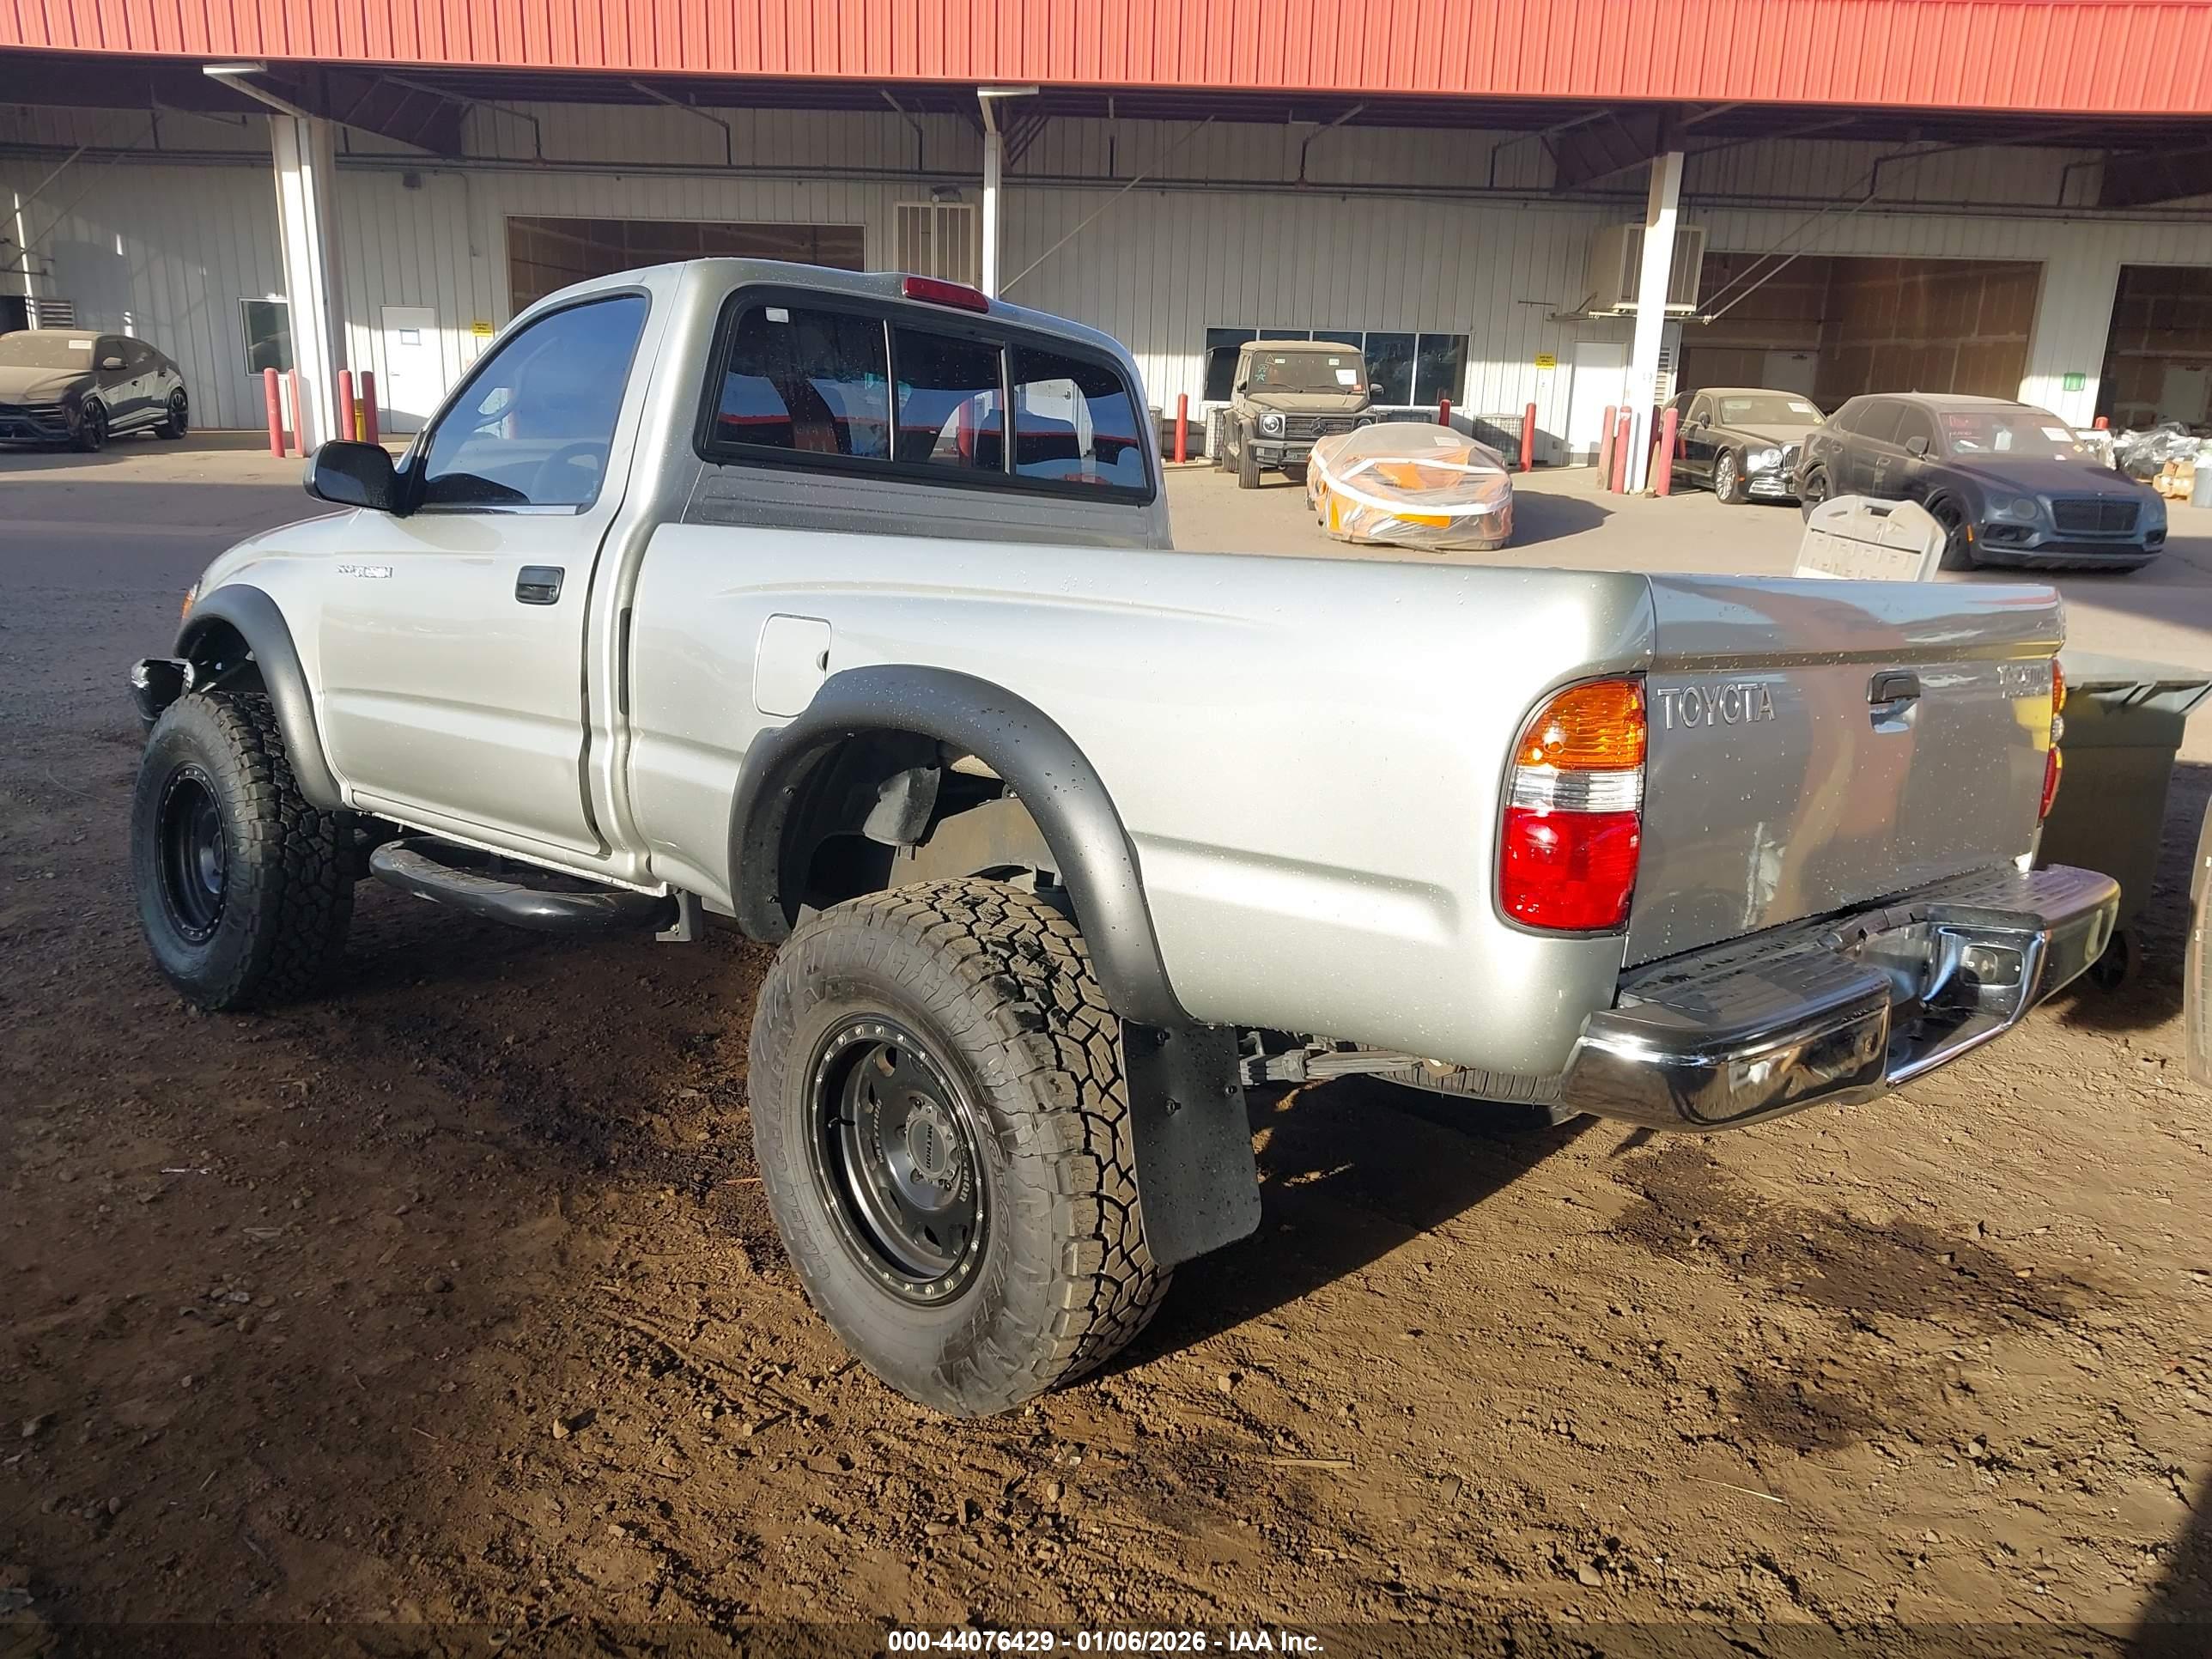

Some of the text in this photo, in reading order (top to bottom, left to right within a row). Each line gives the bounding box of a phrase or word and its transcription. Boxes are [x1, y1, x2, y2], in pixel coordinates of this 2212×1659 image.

[1657, 683, 1776, 730] TOYOTA
[872, 1098, 884, 1164] METHOD
[925, 1124, 934, 1169] METHOD
[977, 1106, 1011, 1237] TOYO
